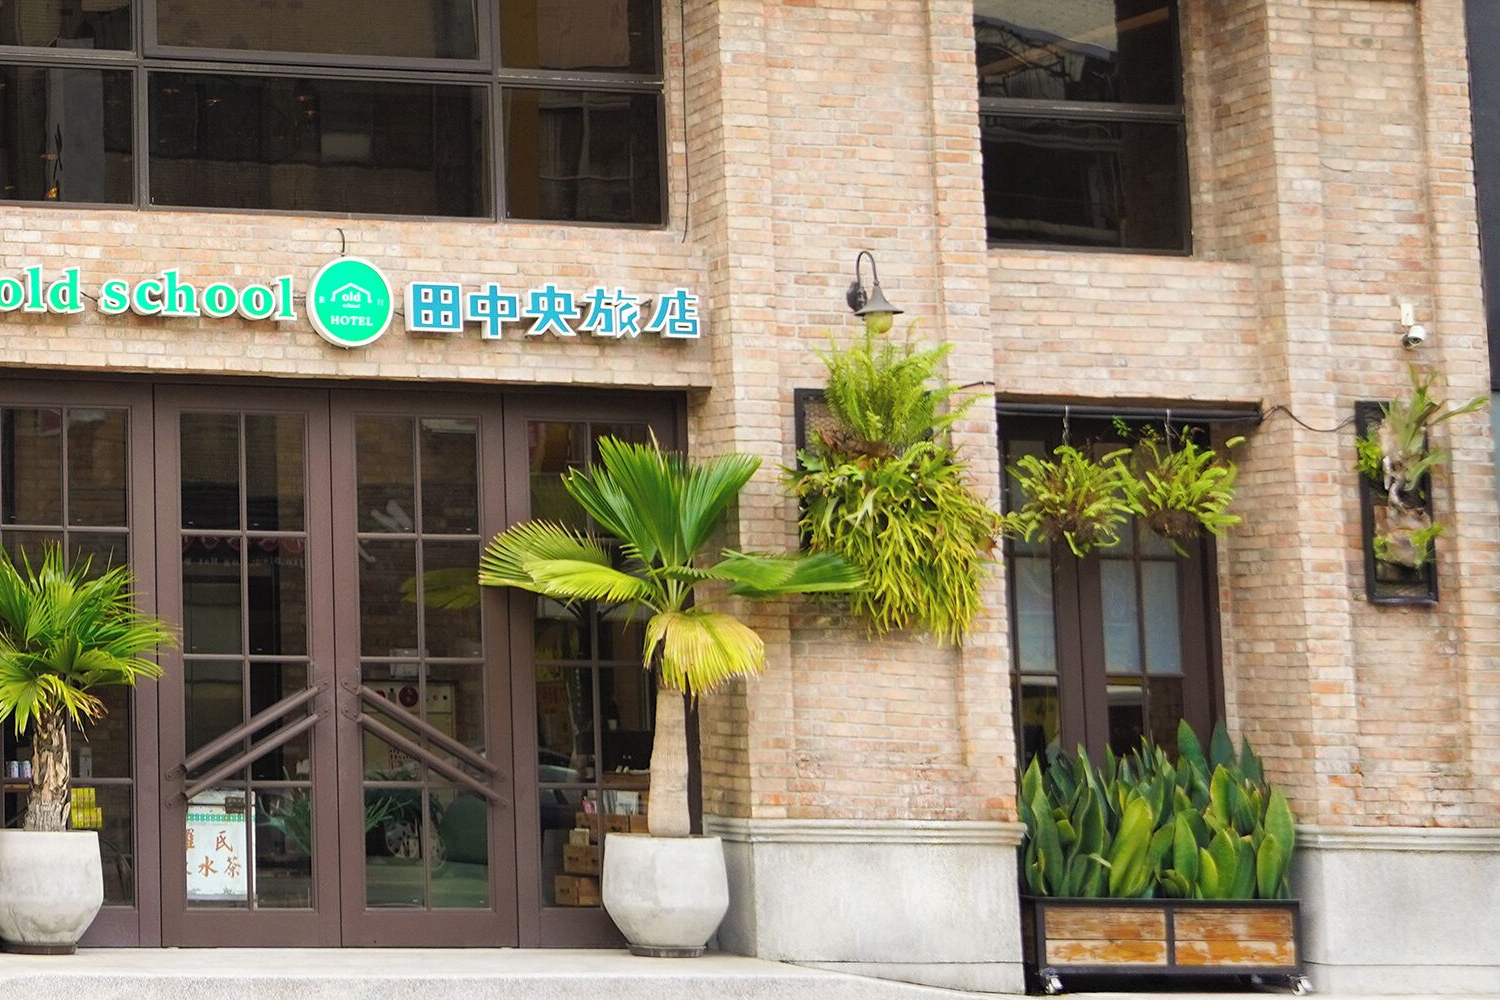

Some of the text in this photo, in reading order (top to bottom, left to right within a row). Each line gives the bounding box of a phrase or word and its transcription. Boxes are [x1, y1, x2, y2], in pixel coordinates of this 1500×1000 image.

[99, 267, 298, 321] school
[341, 291, 361, 303] old
[330, 315, 374, 327] HOTEL
[407, 282, 701, 340] 田中央旅店
[186, 855, 242, 878] 水茶
